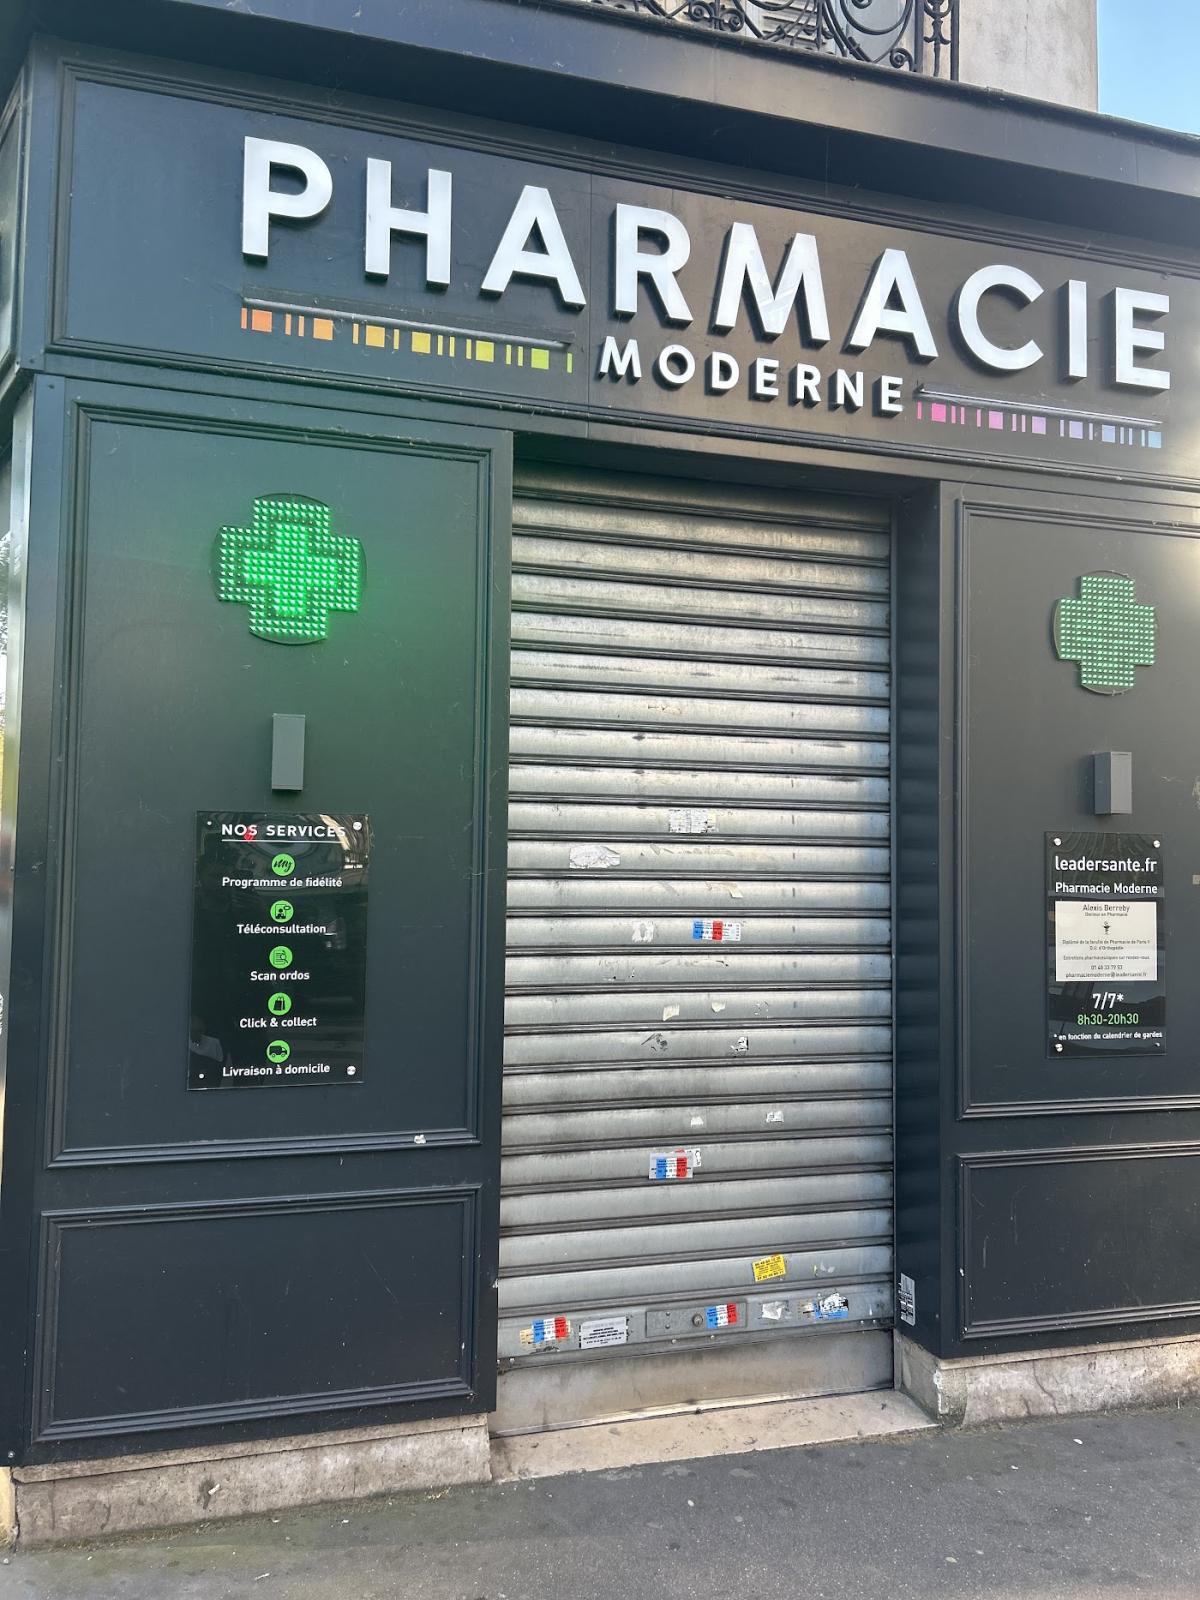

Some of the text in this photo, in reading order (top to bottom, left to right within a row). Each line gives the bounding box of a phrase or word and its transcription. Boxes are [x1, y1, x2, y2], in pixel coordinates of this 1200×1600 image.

[241, 136, 1171, 391] PHARMACIE
[599, 336, 904, 415] MODERNE
[221, 824, 346, 837] NOS SERVICES
[1055, 856, 1157, 872] leadersante.fr
[222, 877, 343, 888] Programme de fidélité
[1055, 882, 1158, 894] Pharmacie Moderne
[237, 923, 326, 934] Téléconsultation
[250, 971, 310, 981] Scan ordos
[239, 1017, 317, 1028] Click & collect
[1077, 1013, 1139, 1025] 8h30-20h30
[1142, 1031, 1163, 1040] gardes
[222, 1063, 330, 1077] Livraison à domicile
